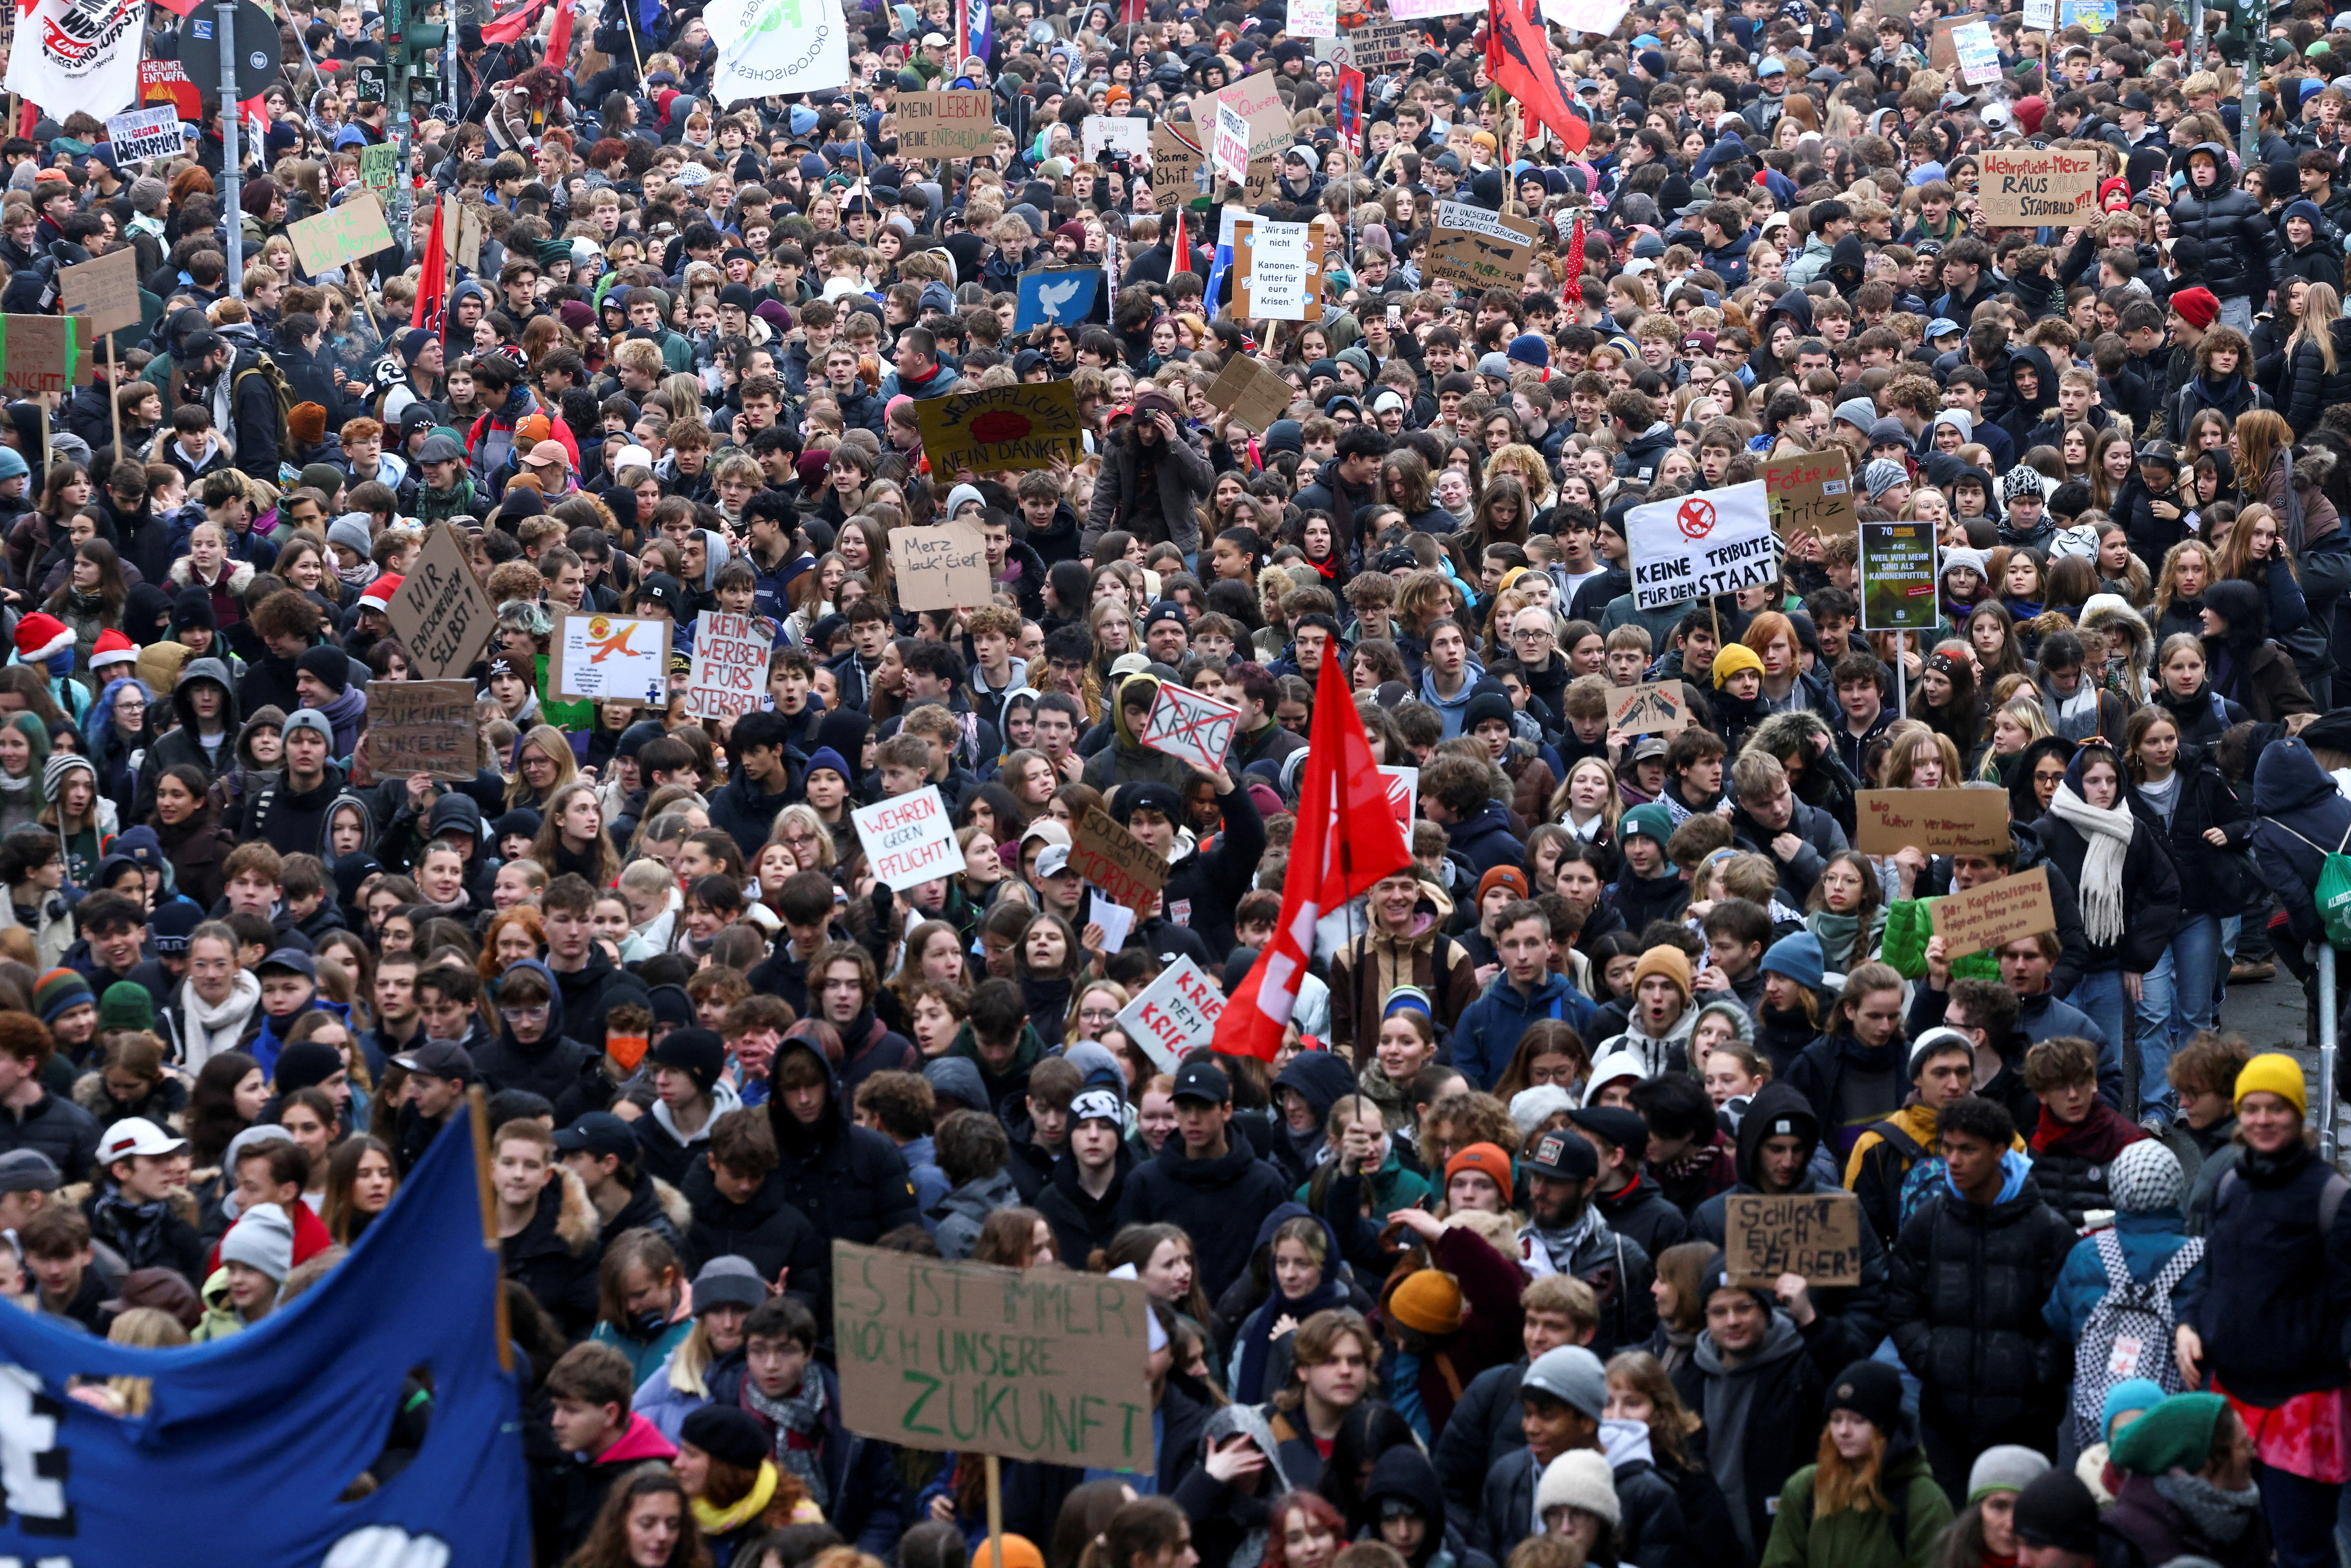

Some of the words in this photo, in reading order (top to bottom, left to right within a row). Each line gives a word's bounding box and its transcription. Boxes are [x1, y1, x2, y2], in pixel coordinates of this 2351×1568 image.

[1301, 26, 1331, 36] GRENZEN
[1351, 30, 1369, 39] WIR
[1373, 25, 1406, 38] STERBEN
[1354, 40, 1380, 53] NICHT
[1384, 36, 1400, 49] FÜR
[141, 60, 184, 72] RHEINMET
[1356, 51, 1385, 66] EUREN
[901, 102, 932, 118] MEIN
[938, 95, 986, 118] LEBEN
[1239, 95, 1280, 116] Queen
[108, 115, 145, 133] WEHR
[144, 108, 174, 124] DICH
[1099, 121, 1128, 136] Bildung
[900, 131, 929, 148] MEINE
[932, 128, 993, 151] ENTSCHEIDUNG
[362, 150, 372, 174] WIR
[373, 149, 397, 172] STERBEN
[1157, 149, 1189, 163] Same
[1985, 155, 2090, 179] Wehrpflicht-Merz
[370, 172, 386, 186] NICHT
[1156, 166, 1188, 186] Shit
[1245, 175, 1266, 198] ay
[2002, 176, 2048, 194] RAUS
[2052, 175, 2083, 194] AUS
[1445, 205, 1454, 214] IN
[1460, 208, 1497, 223] UNSEREN
[1985, 197, 2016, 215] DEM
[299, 211, 357, 240] Merz
[1442, 215, 1531, 244] GESCHICHTSBÜCHERN
[309, 240, 332, 268] du
[1258, 261, 1299, 270] Kanonen-
[1260, 273, 1283, 282] futter
[1285, 274, 1297, 282] für
[1504, 271, 1524, 282] FÜR
[942, 445, 989, 475] NEIN
[1775, 496, 1845, 529] Fritz
[1881, 527, 1893, 536] 70
[905, 537, 952, 555] Merz
[1908, 553, 1929, 561] MEHR
[946, 552, 982, 569] Eier
[1636, 557, 1691, 584] KEINE
[1706, 536, 1771, 567] TRIBUTE
[1638, 586, 1668, 608] FÜR
[1671, 581, 1696, 599] DEN
[1699, 558, 1771, 597] STAAT
[1869, 571, 1931, 580] KANONENFUTTER.
[407, 563, 442, 615] WIR
[410, 567, 462, 659] ENTSCHEIDEN
[708, 613, 750, 639] KEIN
[697, 636, 767, 668] WERBEN
[490, 667, 511, 675] adidas
[703, 662, 754, 690] FÜRS
[1636, 684, 1656, 693] EUREN
[1615, 695, 1635, 718] GEGEN
[1658, 689, 1679, 706] KRIEG
[1148, 697, 1230, 755] KRIEG
[864, 795, 936, 834] WEHREN
[1882, 813, 1914, 828] Kultur
[884, 823, 924, 849] GEGEN
[1085, 811, 1170, 878] SOLDATEN
[1107, 844, 1131, 868] SIND
[1942, 904, 1961, 920] Der
[1967, 882, 2043, 913] Kapitalismus
[1176, 970, 1223, 1022] KRIE
[1169, 997, 1202, 1033] DEM
[1746, 1224, 1808, 1250] EUCH
[837, 1253, 887, 1316] ES
[907, 1265, 970, 1317] IST
[1002, 1280, 1132, 1337] IMMER
[837, 1318, 920, 1367] NOCH
[938, 1330, 1065, 1376] UNSERE
[902, 1370, 1143, 1458] ZUKUNFT
